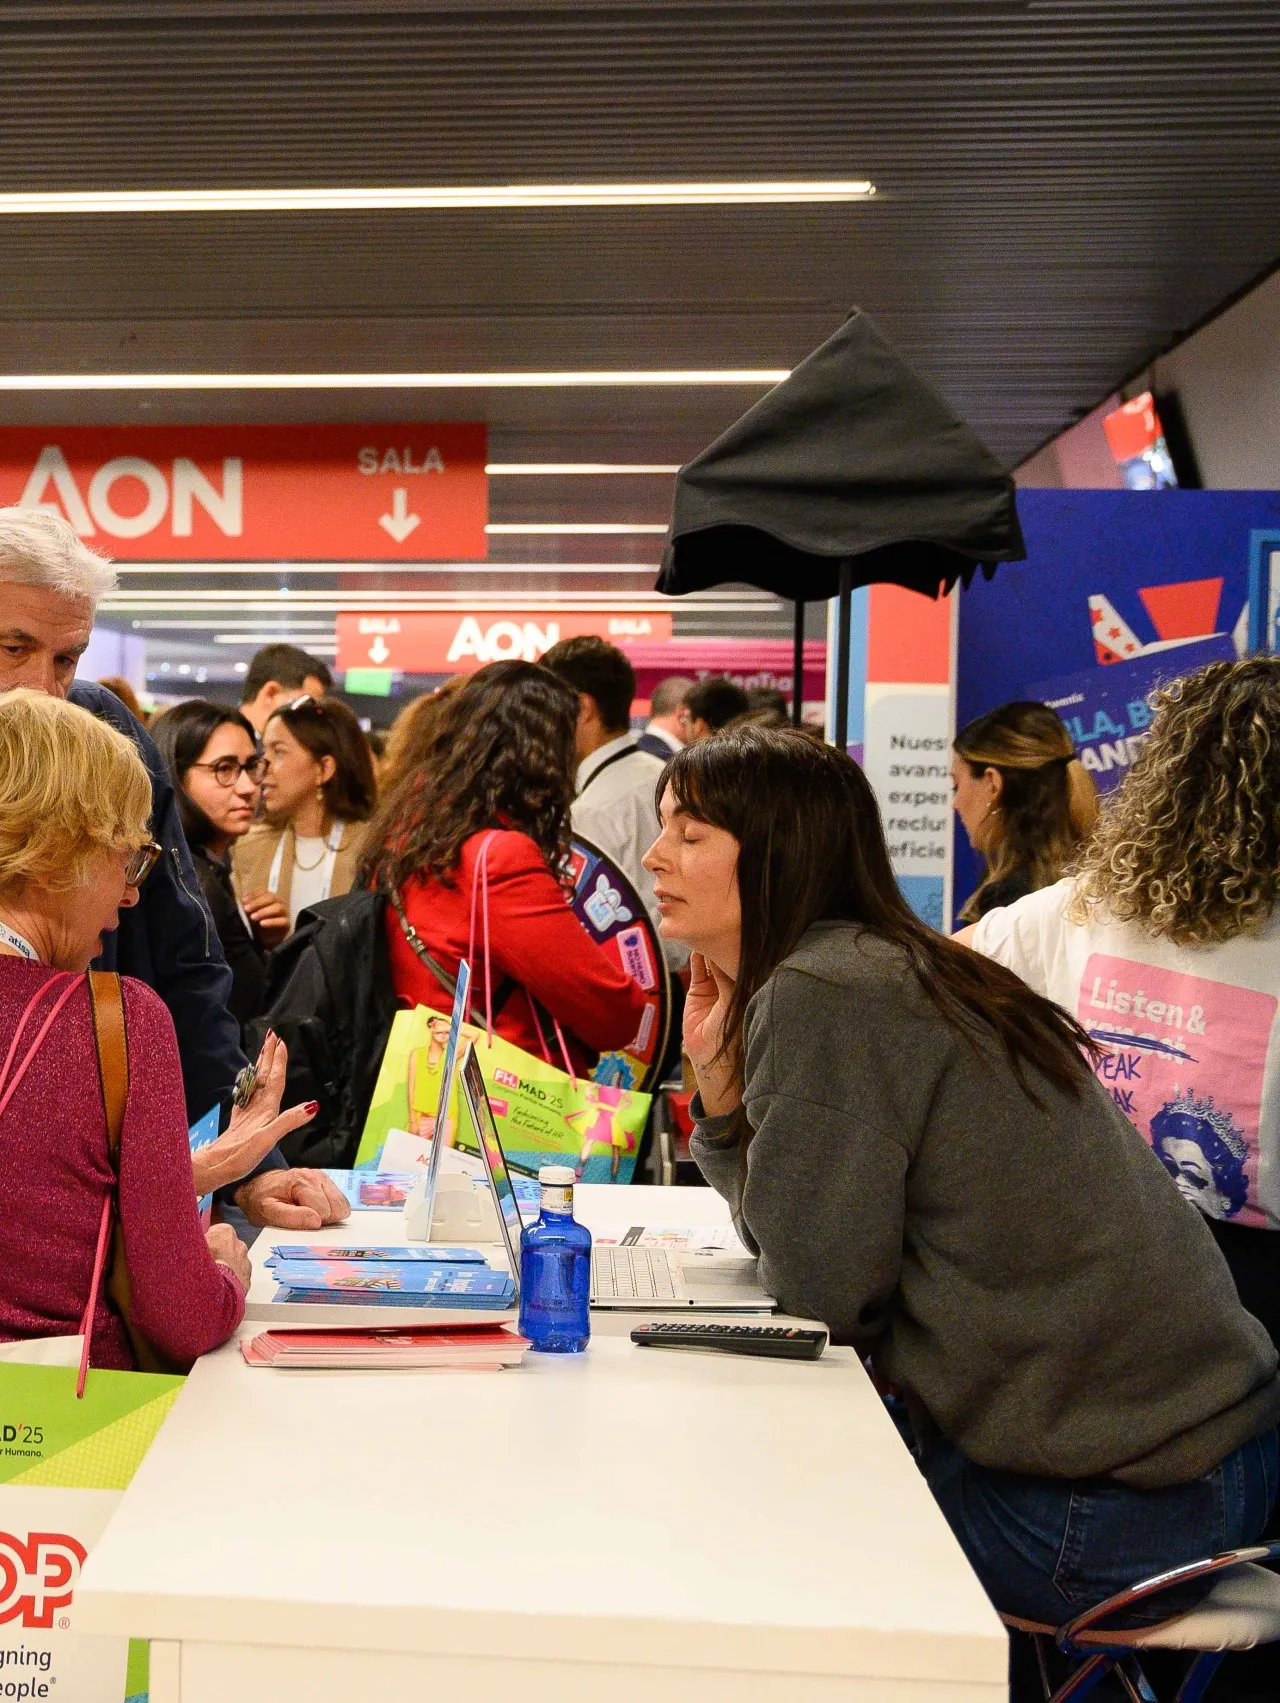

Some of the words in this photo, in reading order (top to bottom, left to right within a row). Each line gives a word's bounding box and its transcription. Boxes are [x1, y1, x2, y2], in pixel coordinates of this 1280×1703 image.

[357, 447, 445, 475] SALA
[20, 445, 244, 538] AON
[446, 616, 560, 662] AON
[8, 935, 31, 958] atisa
[1089, 976, 1183, 1030] Listen
[1185, 1004, 1207, 1036] &
[4, 1447, 44, 1458] Humano.
